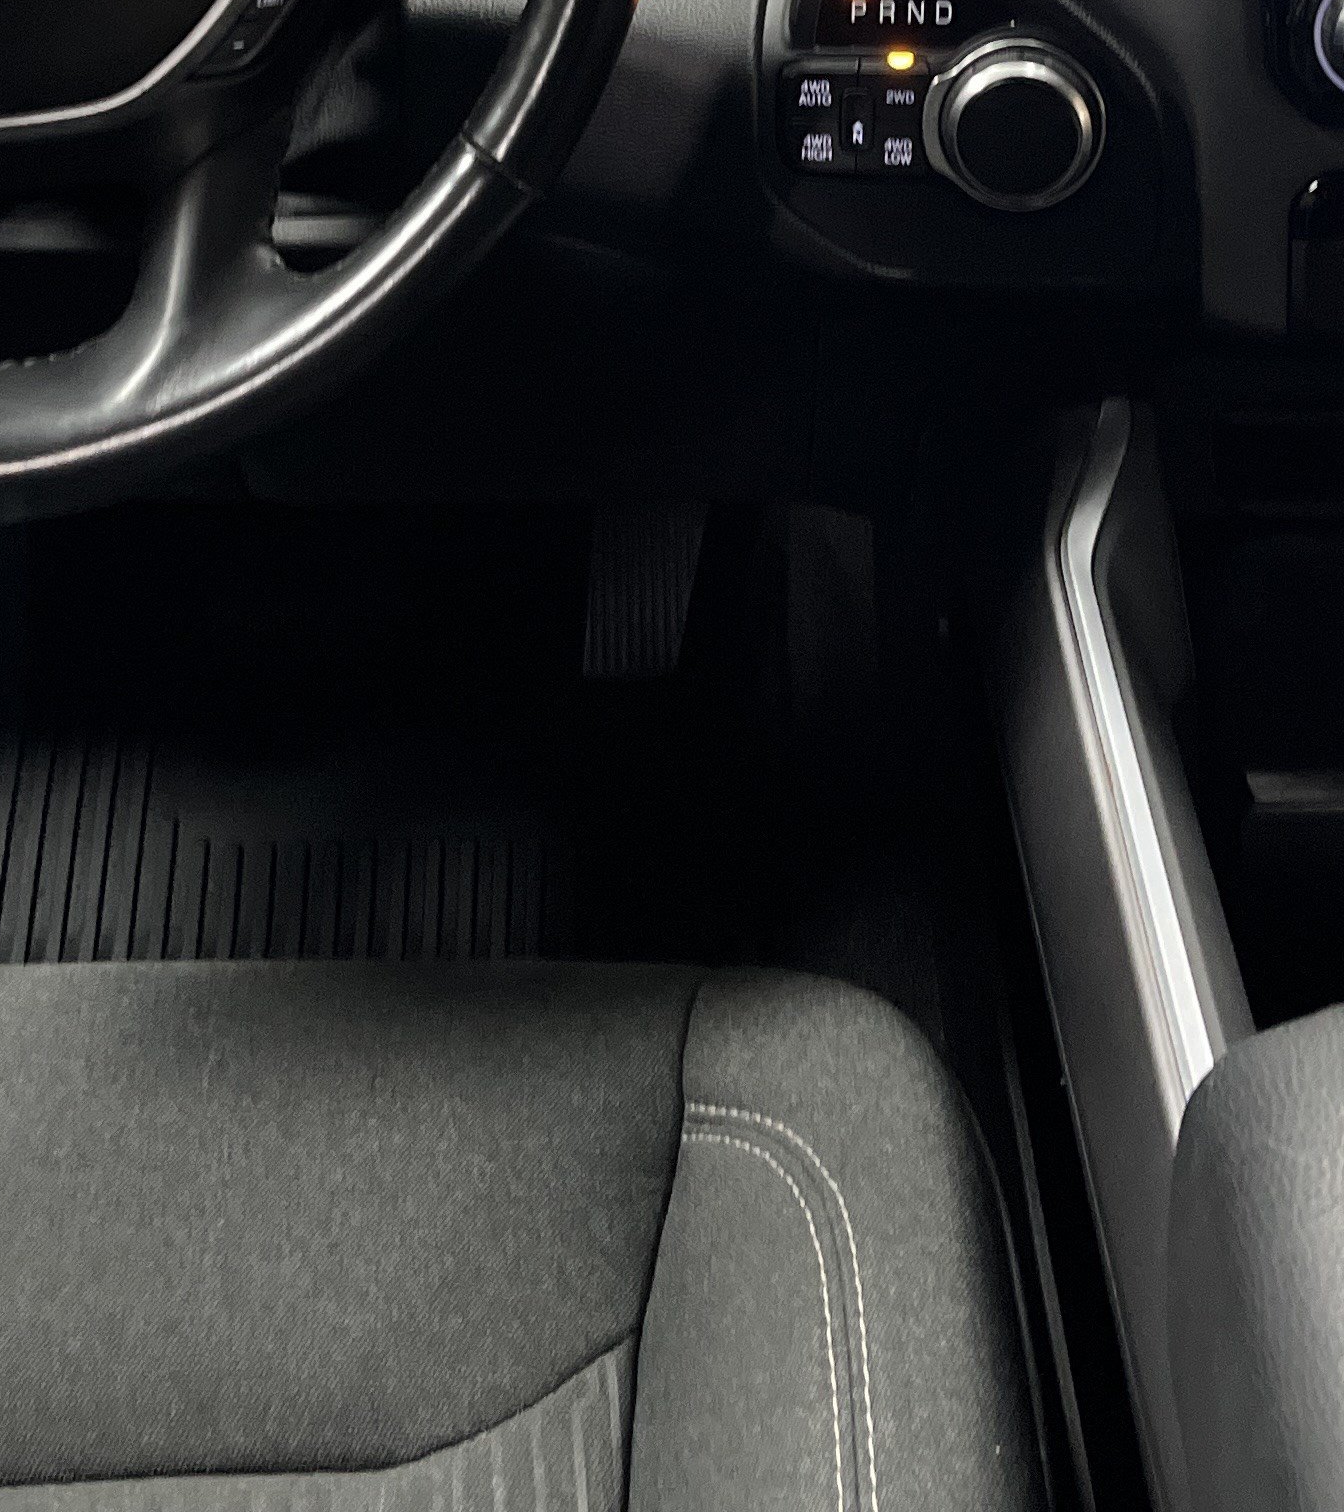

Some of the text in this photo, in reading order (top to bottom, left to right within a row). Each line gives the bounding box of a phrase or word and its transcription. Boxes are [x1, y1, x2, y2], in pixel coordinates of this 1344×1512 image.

[907, 0, 925, 26] N
[935, 0, 953, 26] D
[798, 92, 832, 107] AUTO
[884, 150, 912, 167] LOW
